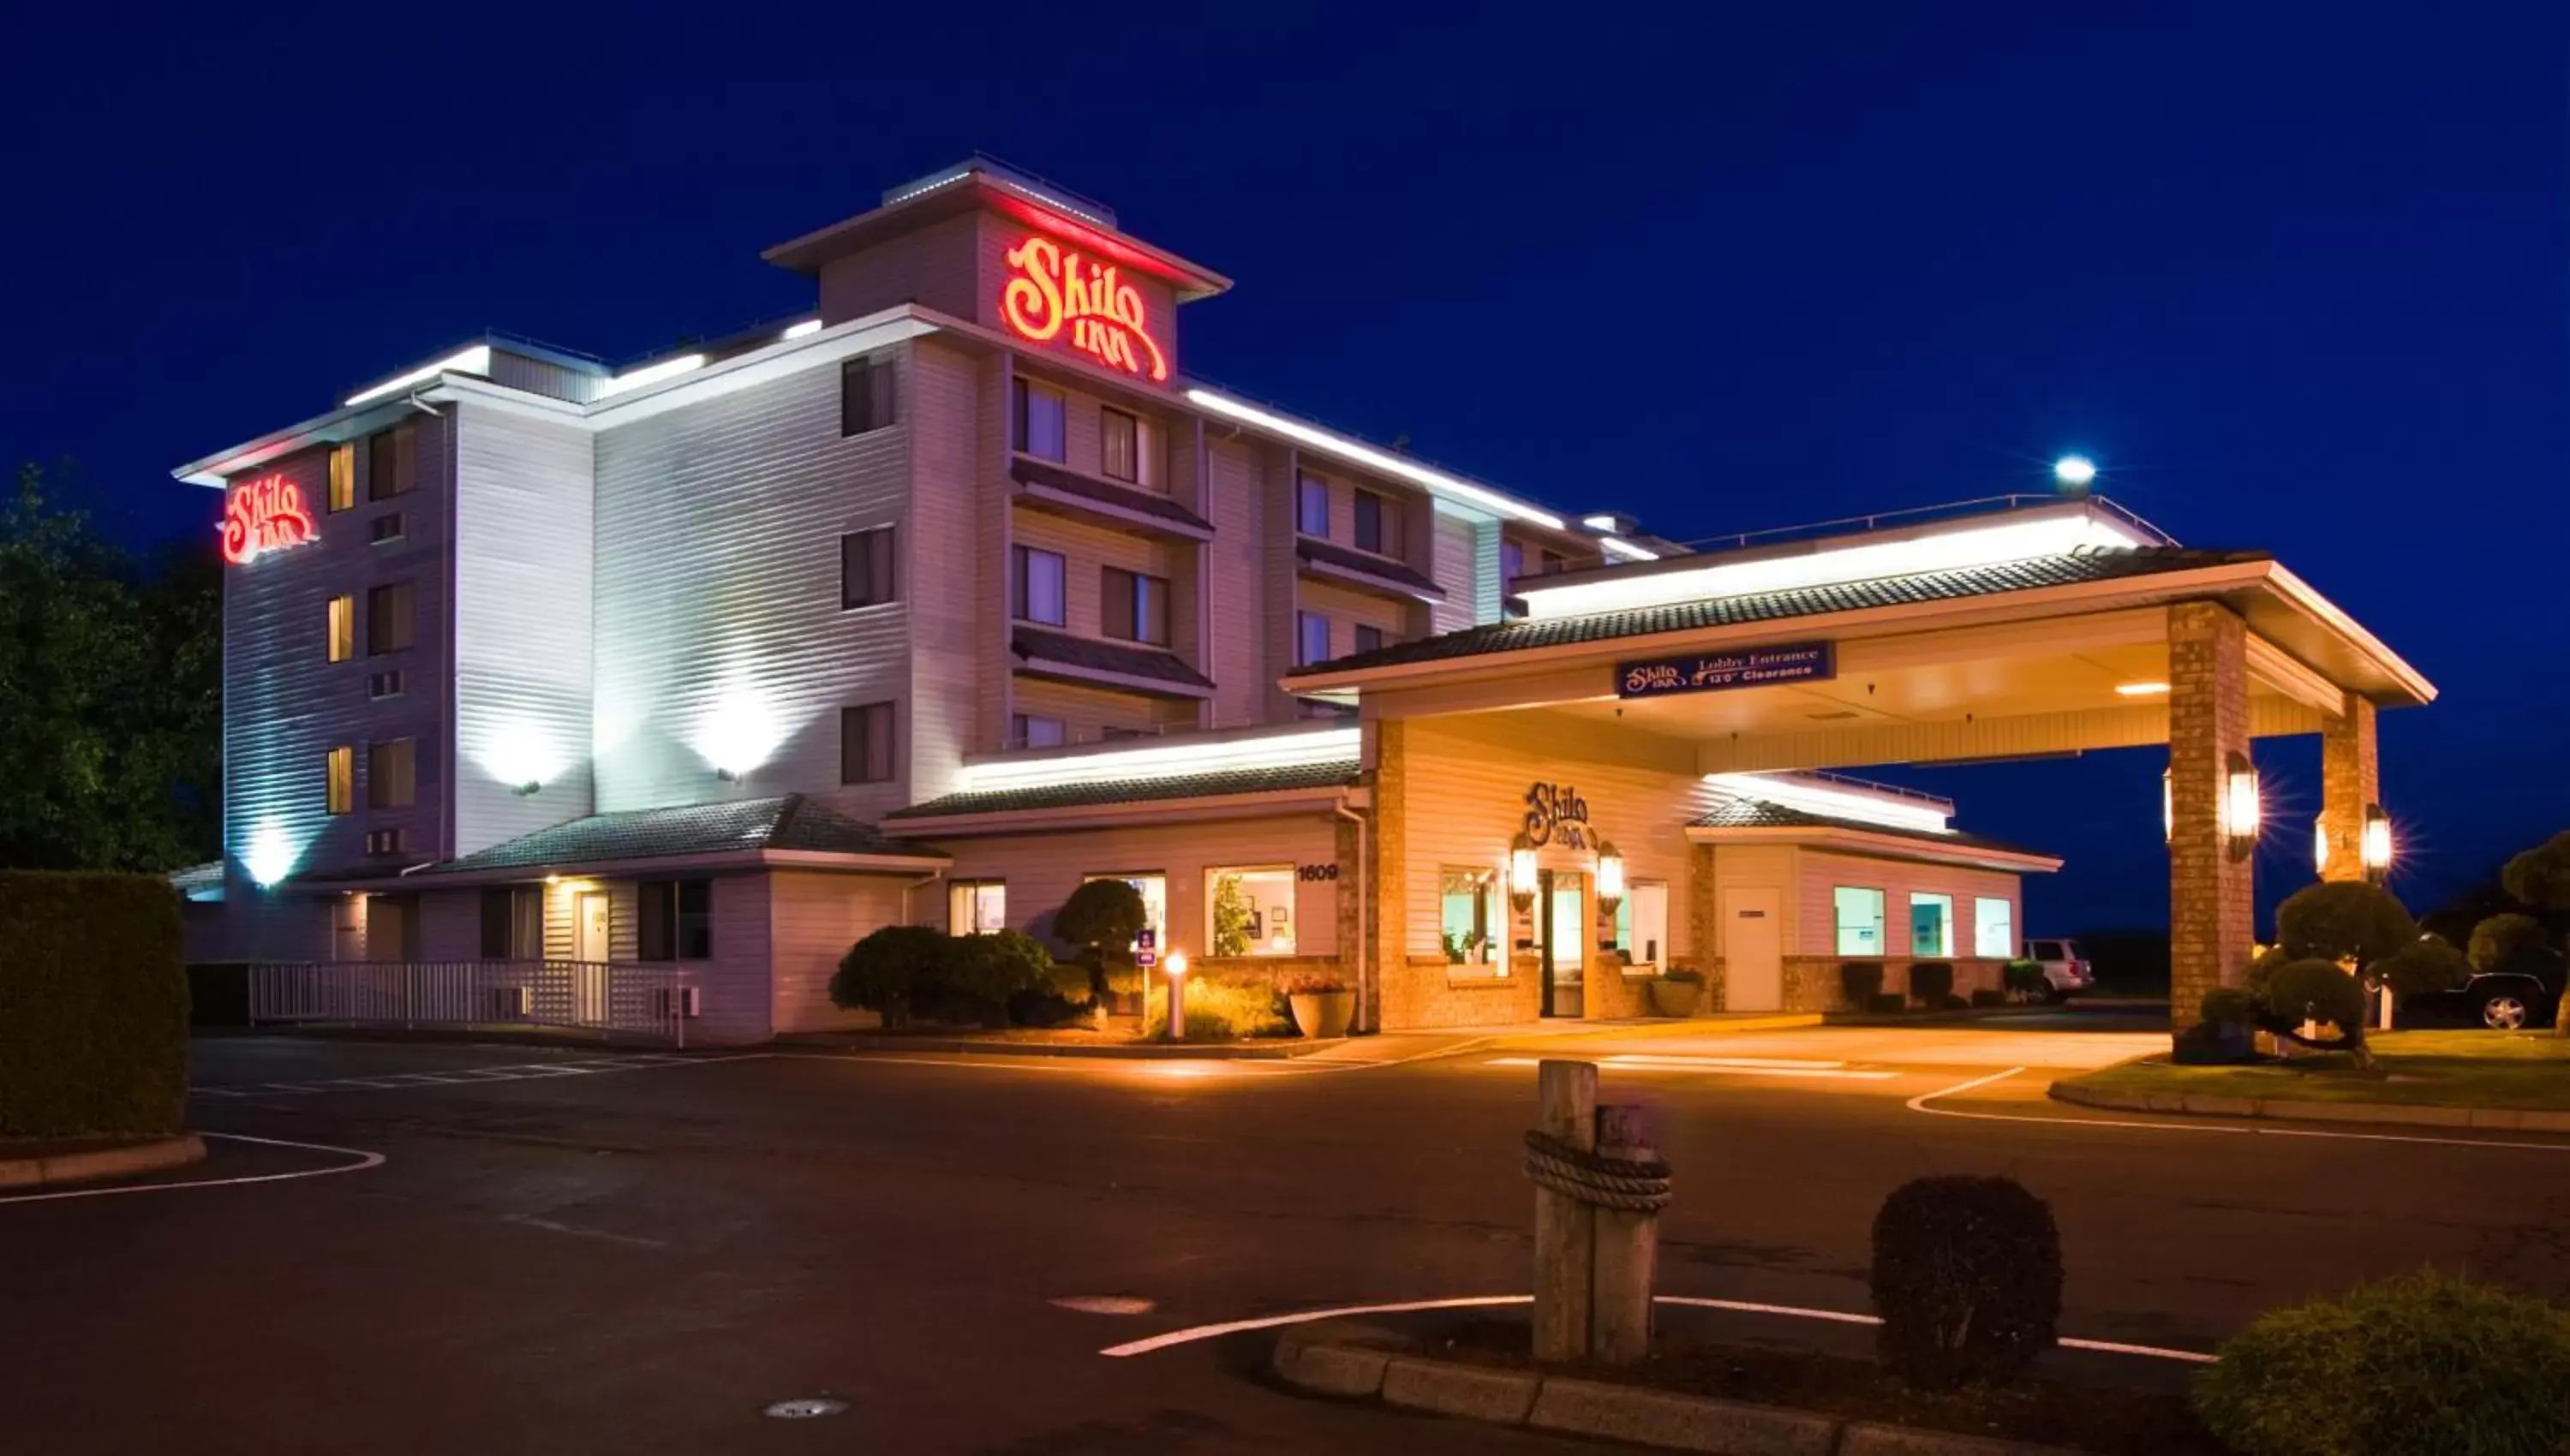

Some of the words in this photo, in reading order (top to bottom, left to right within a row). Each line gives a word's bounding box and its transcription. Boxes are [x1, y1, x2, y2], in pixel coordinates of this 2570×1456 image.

[1005, 236, 1167, 381] Shilo
[224, 474, 313, 564] Shilo
[1748, 650, 1819, 666] Entrance
[1625, 665, 1687, 693] Shilo
[1742, 666, 1813, 682] Clearance
[1524, 781, 1599, 850] Shilo
[1296, 863, 1338, 882] 1609
